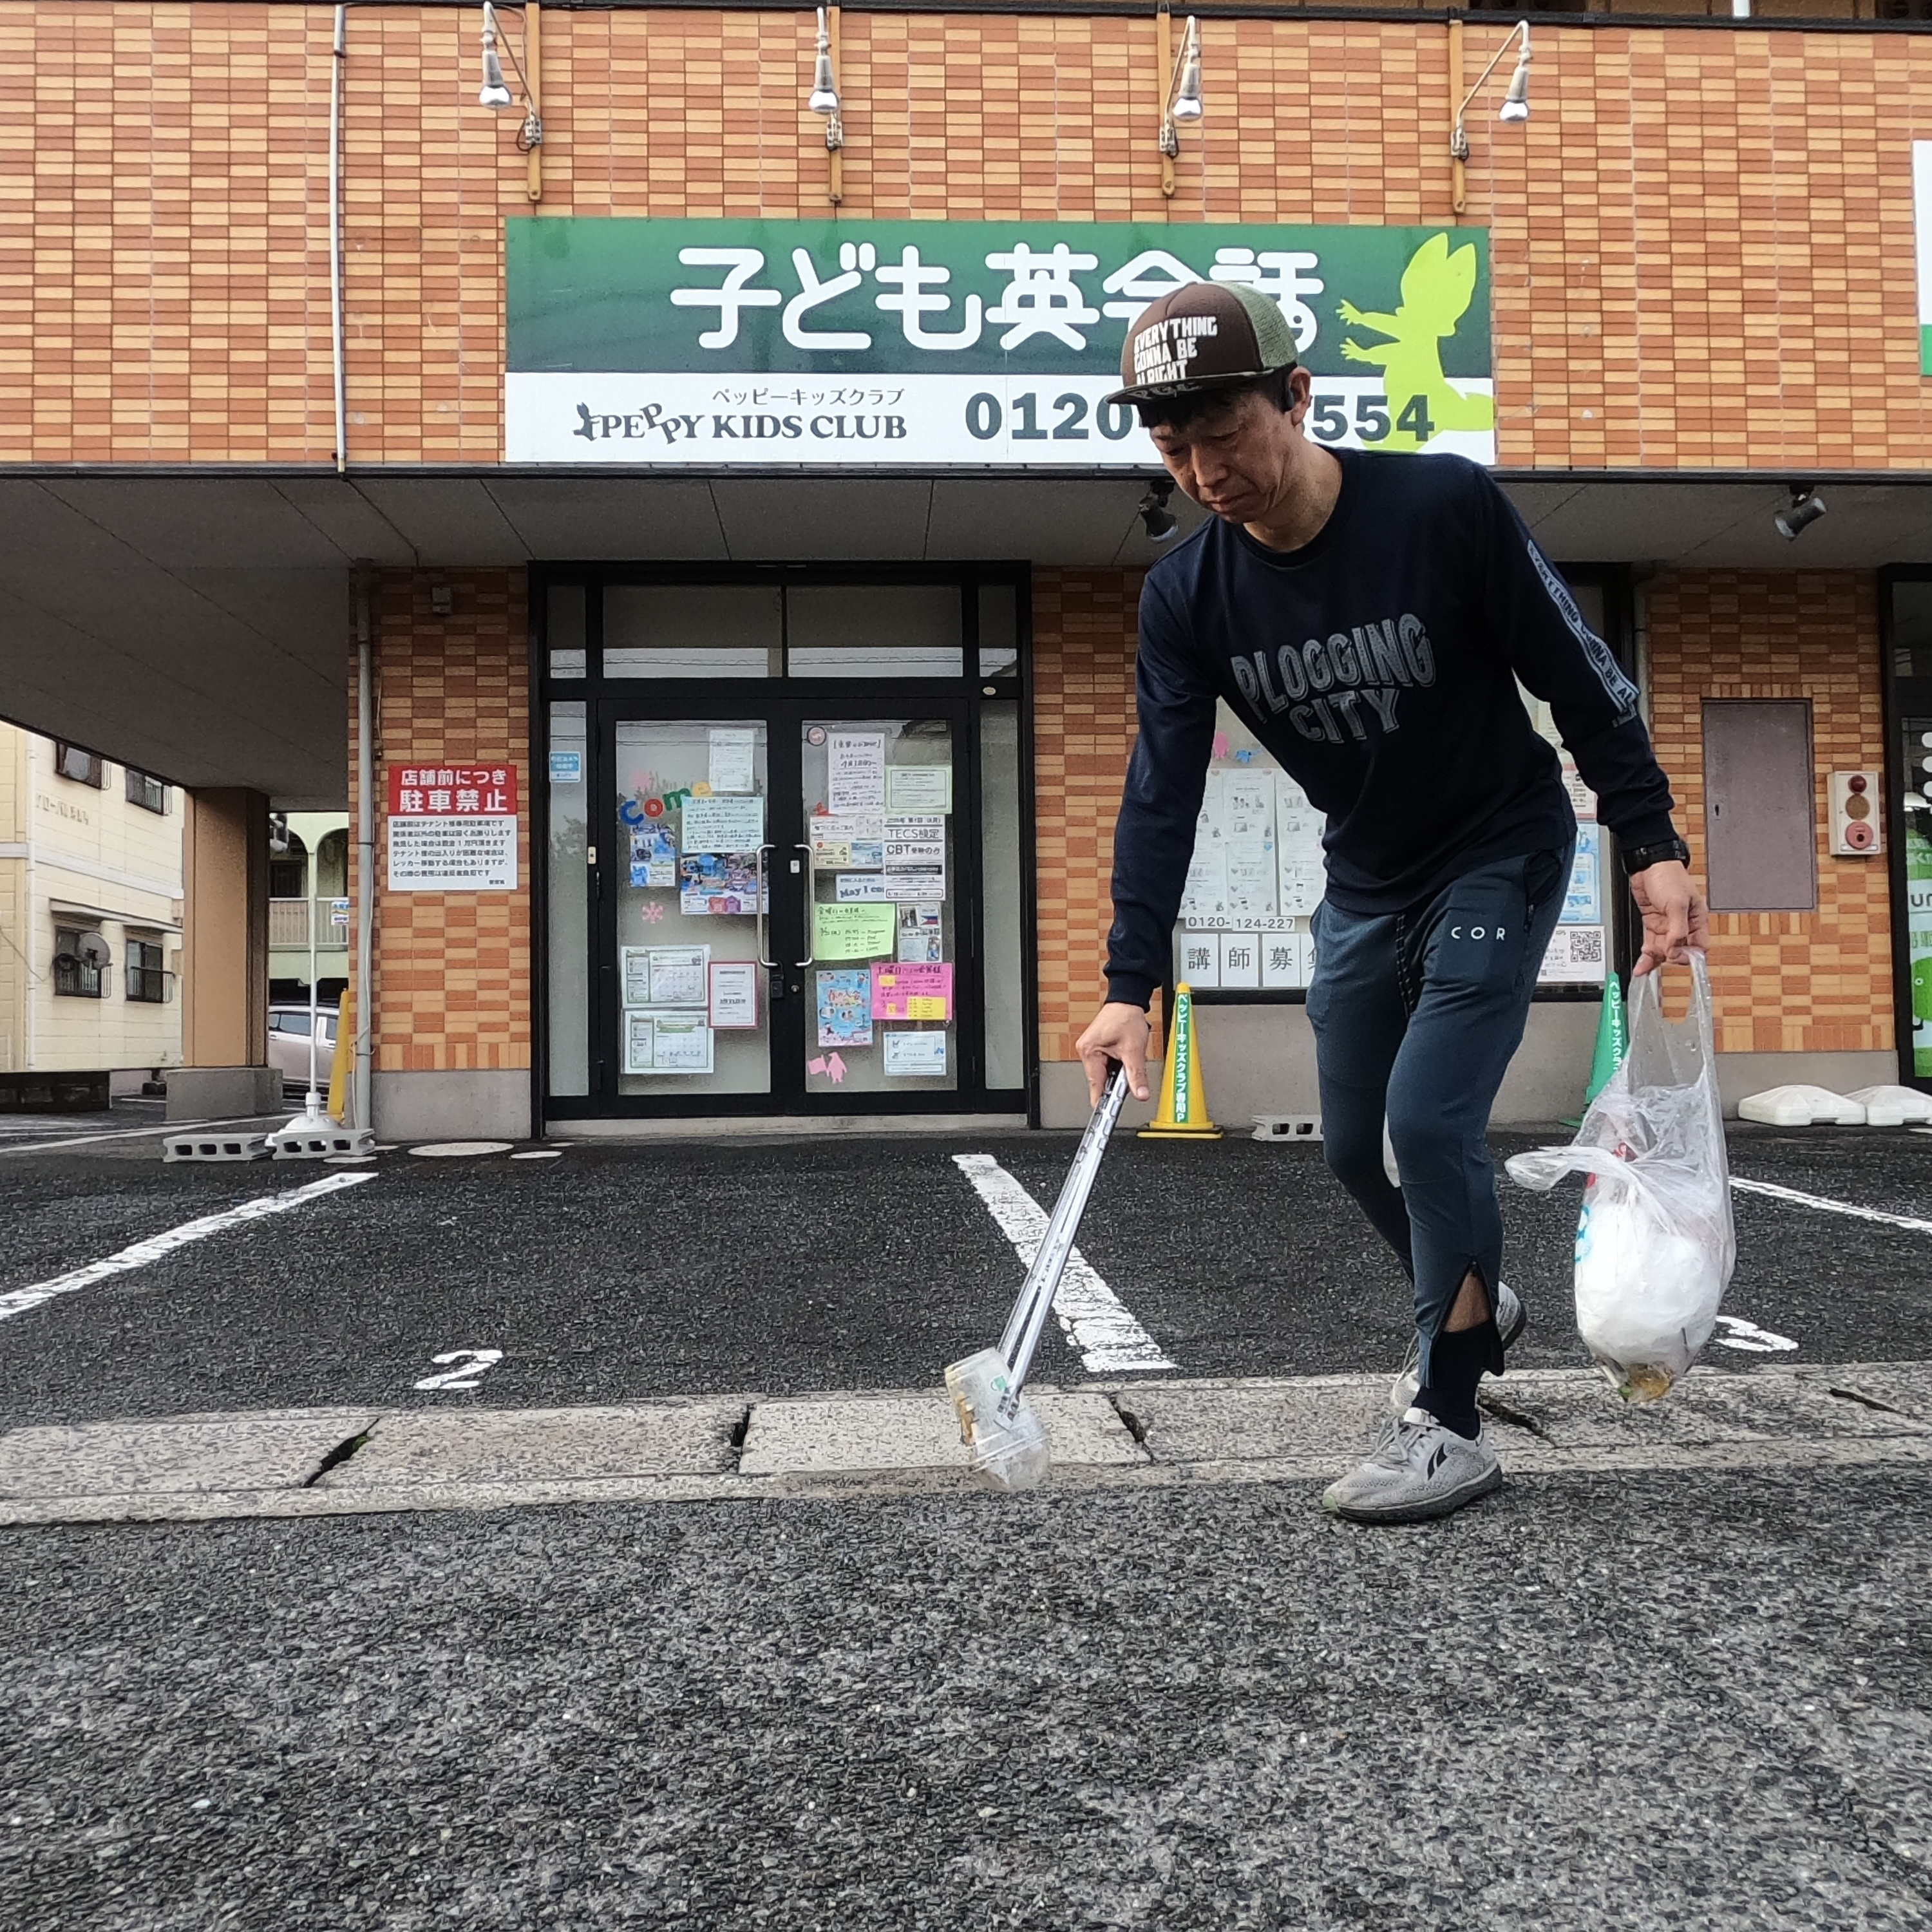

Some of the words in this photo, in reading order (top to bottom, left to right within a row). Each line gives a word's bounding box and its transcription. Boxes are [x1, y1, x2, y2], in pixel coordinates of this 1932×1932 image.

[1133, 316, 1218, 354] EVERYTHING
[1133, 341, 1172, 374] GONNA
[1176, 337, 1198, 360] BE
[712, 388, 905, 406] ペッピーキッズクラブ
[600, 402, 703, 444] PEPPY
[712, 415, 802, 439] KIDS
[810, 415, 907, 439] CLUB
[1229, 612, 1436, 725] PLOGGING
[1289, 687, 1401, 744] CITY
[401, 769, 507, 786] 店舗前につき
[399, 788, 508, 813] 駐車禁止
[412, 1349, 503, 1390] 2
